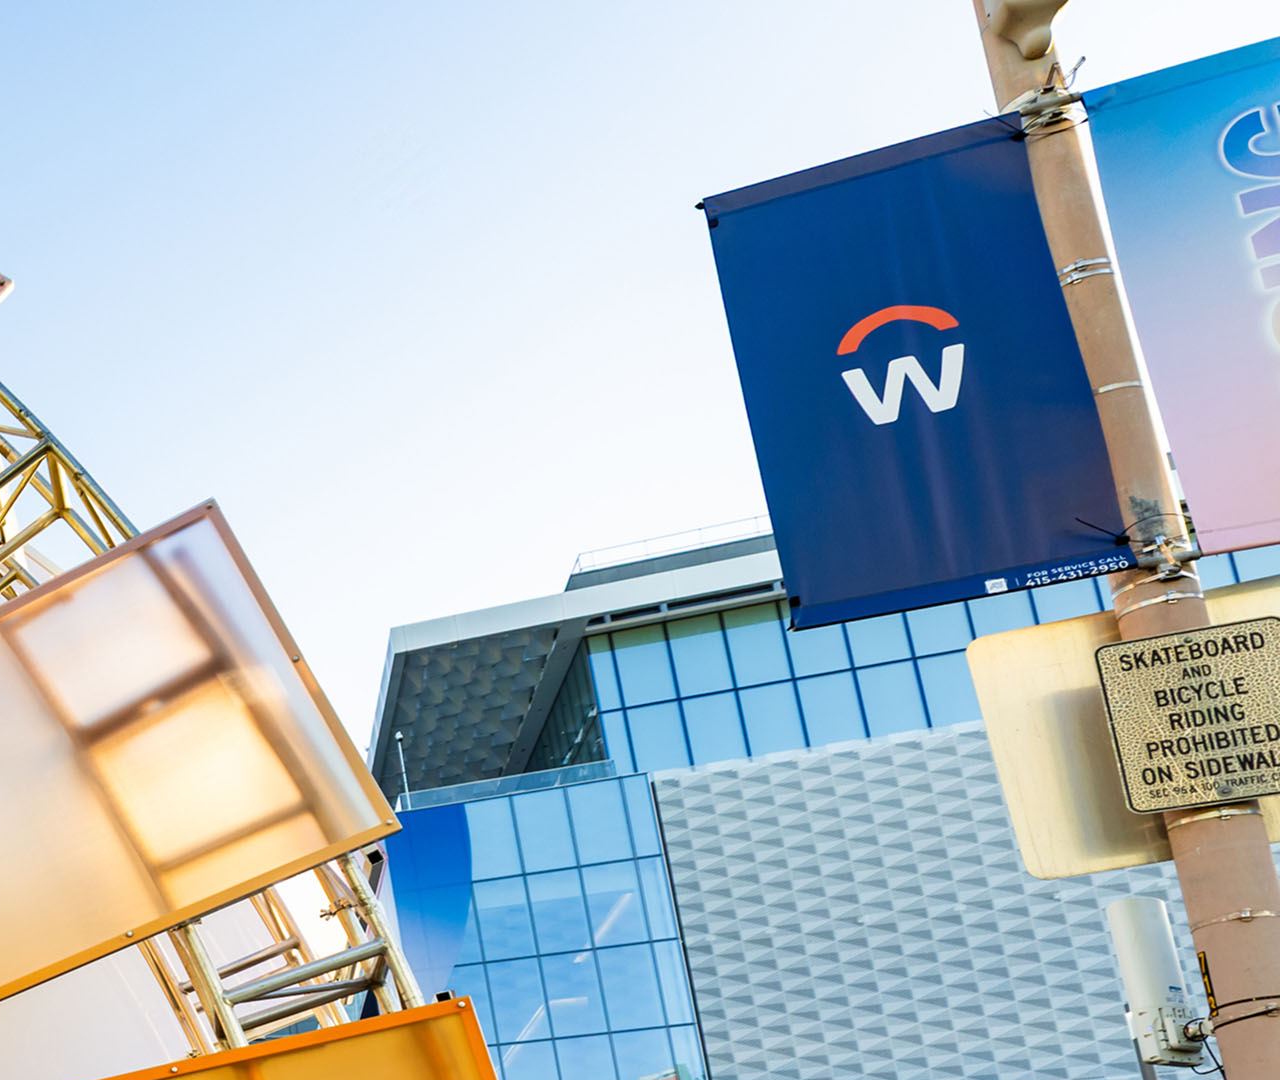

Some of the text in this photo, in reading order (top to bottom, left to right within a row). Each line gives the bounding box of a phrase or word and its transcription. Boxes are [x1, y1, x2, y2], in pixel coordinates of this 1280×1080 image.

[1025, 560, 1129, 587] 415-431-2950
[1026, 555, 1127, 579] FOR SERVICE CALL
[1119, 632, 1265, 672] SKATEBOARD
[1182, 664, 1212, 680] AND
[1154, 677, 1248, 708] BICYCLE
[1169, 703, 1245, 731] RIDING
[1146, 723, 1280, 760] PROHIBITED
[1141, 750, 1280, 786] ON SIDEWAL
[1149, 788, 1169, 799] SEC
[1225, 774, 1267, 788] TRAFFIC
